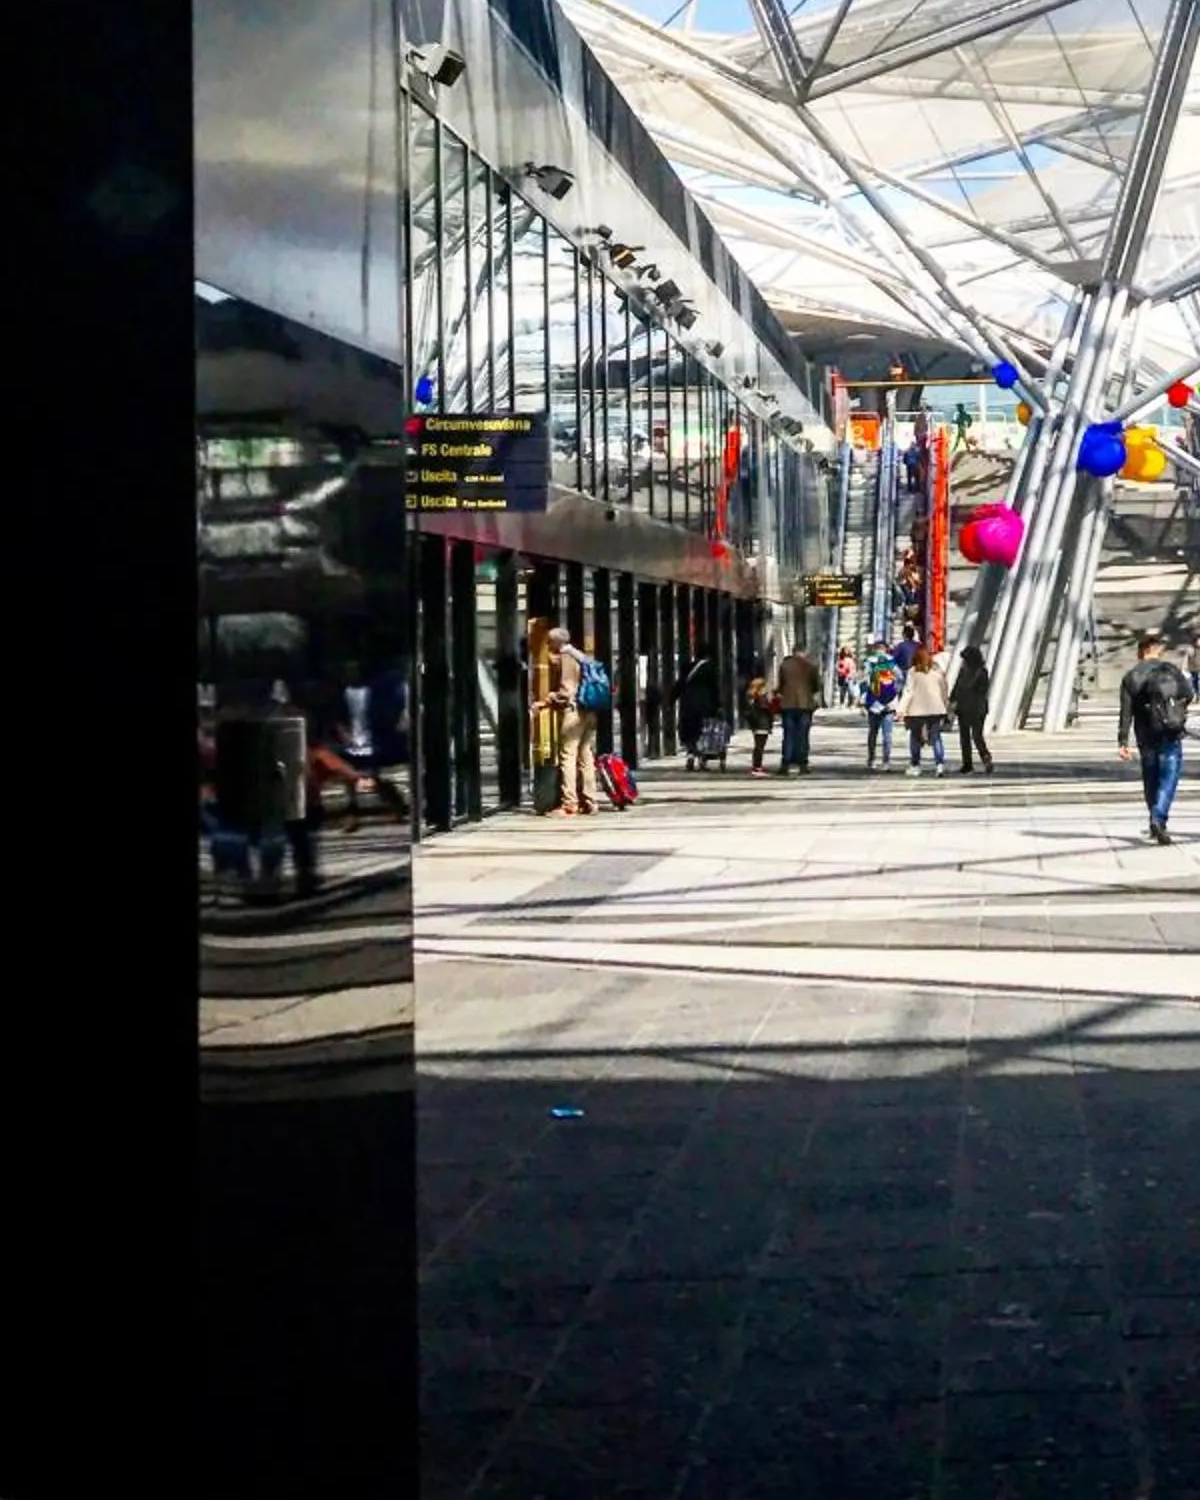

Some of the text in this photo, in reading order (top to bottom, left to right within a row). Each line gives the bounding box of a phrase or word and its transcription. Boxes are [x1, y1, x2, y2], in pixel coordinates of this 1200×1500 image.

[421, 443, 493, 457] FS Centrale
[421, 469, 457, 483] Uscita
[421, 494, 457, 508] Uscita
